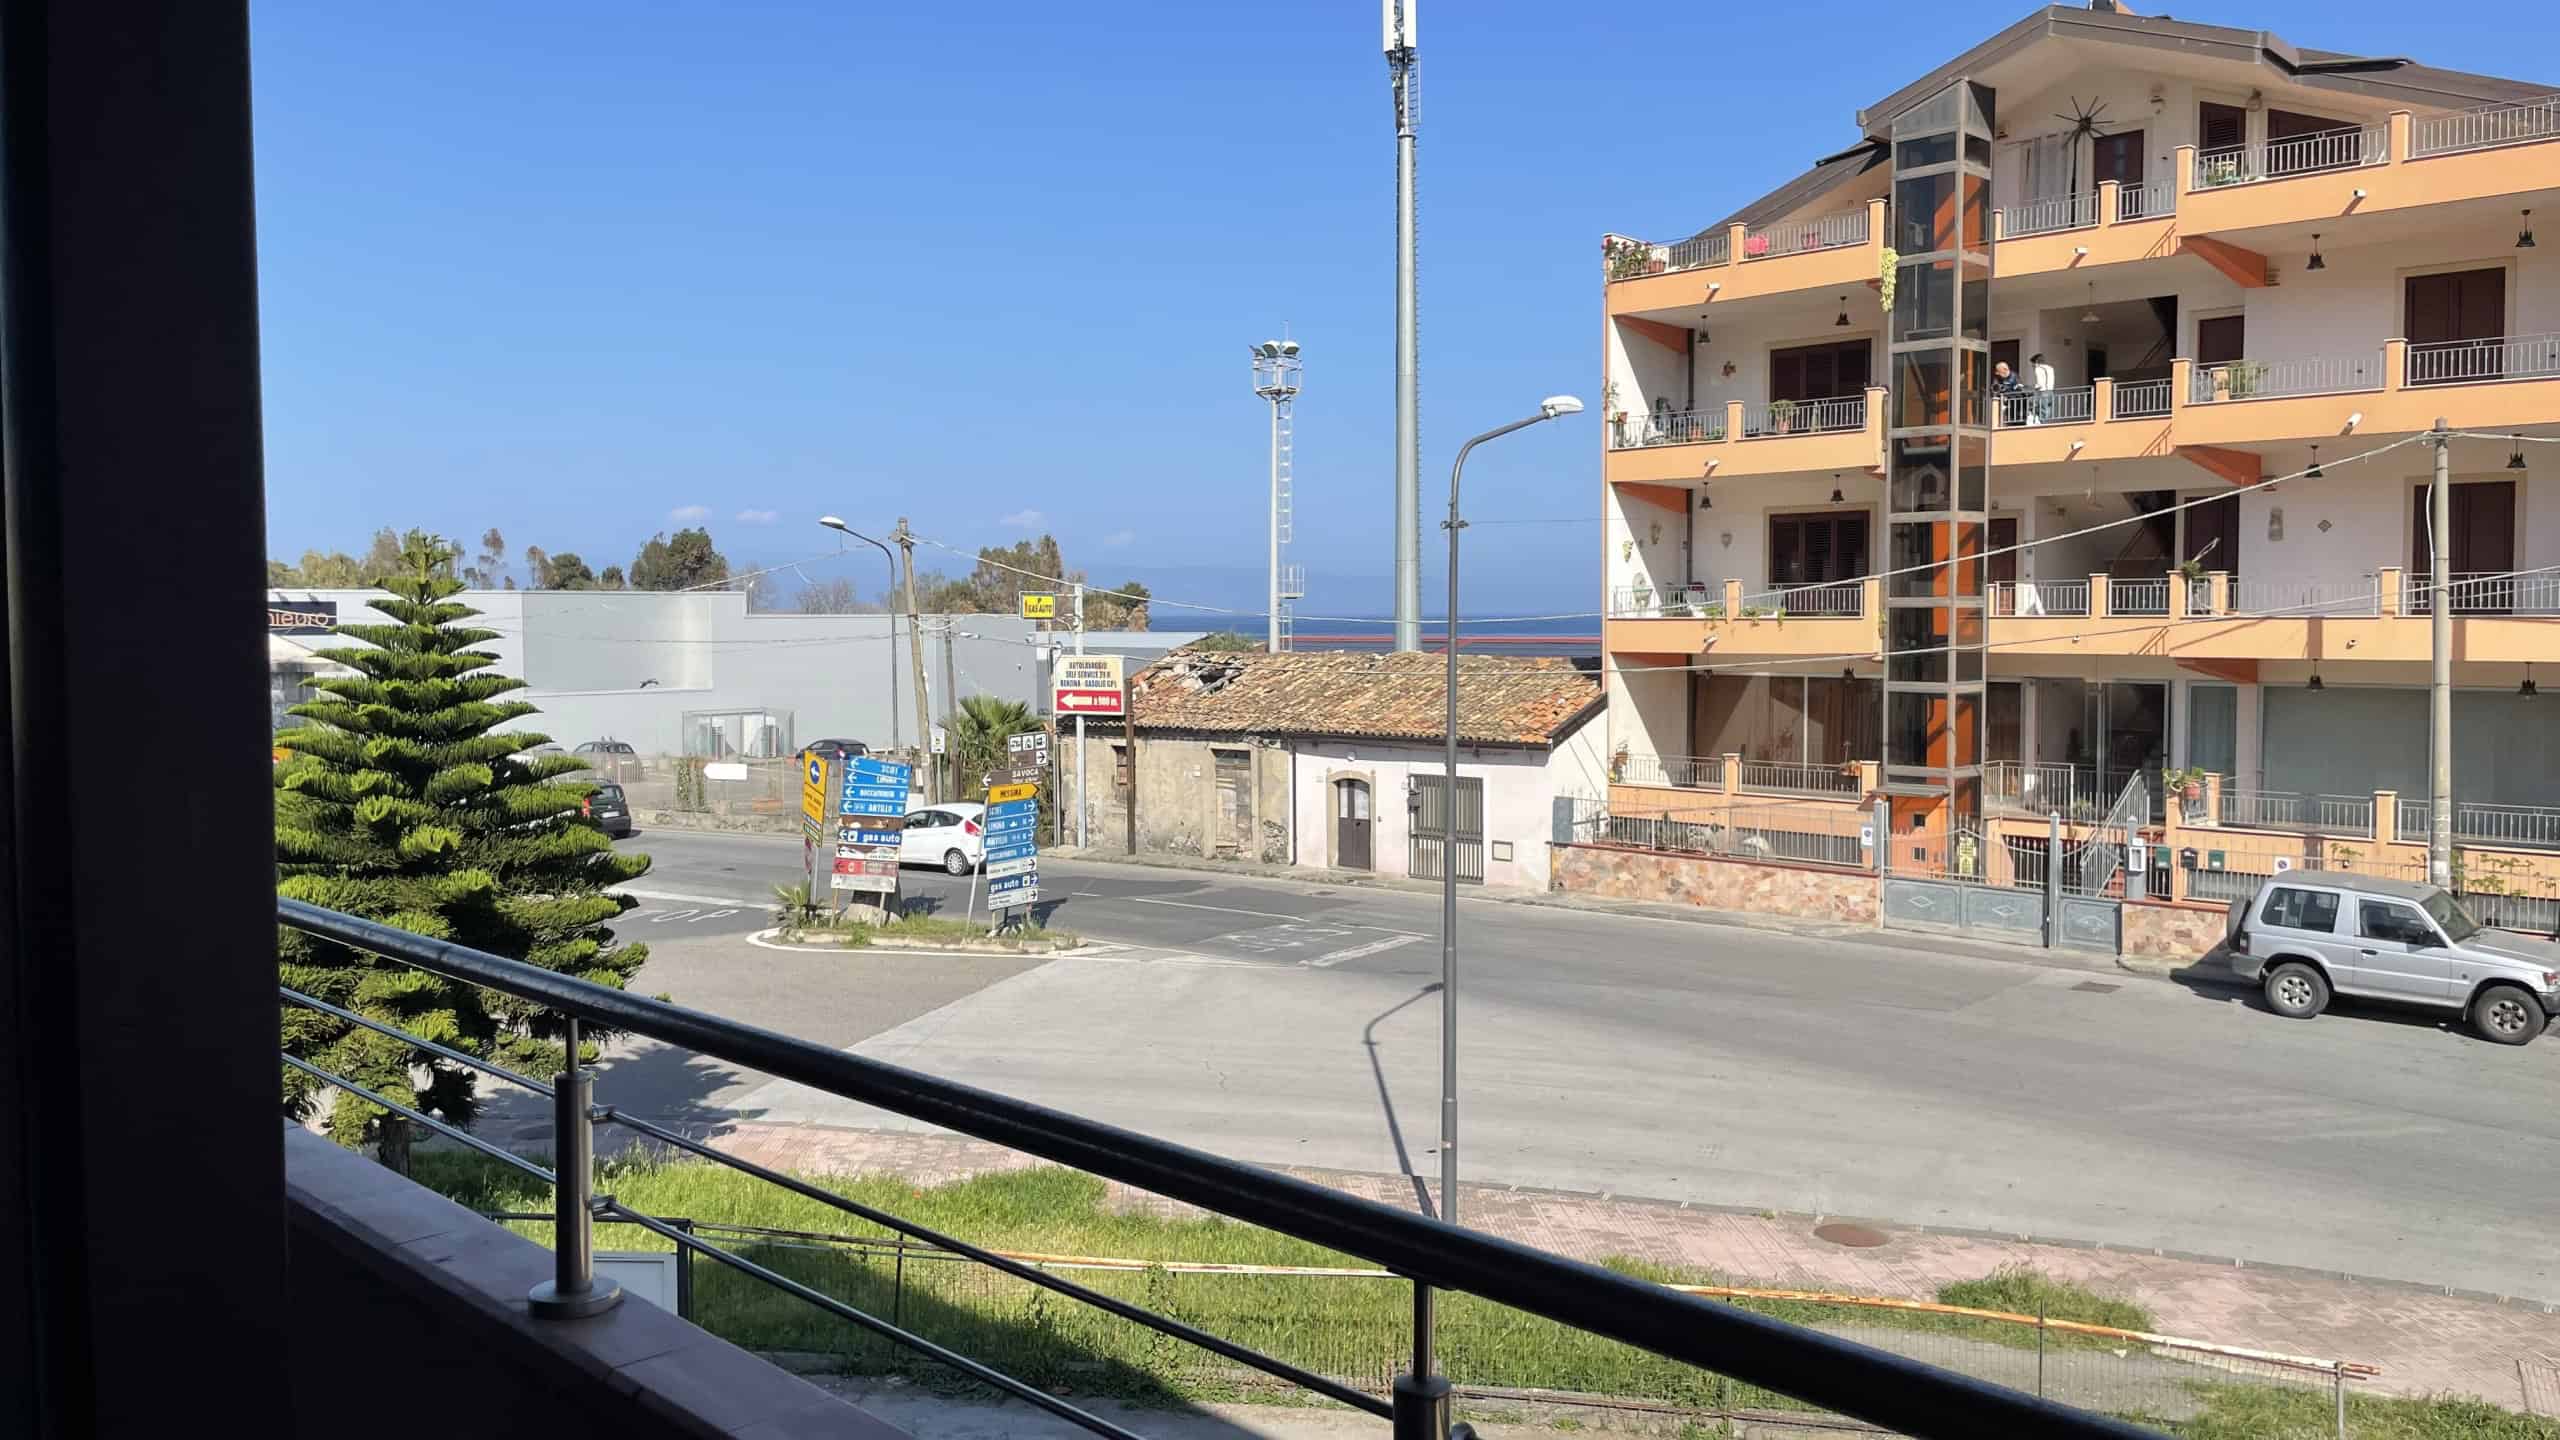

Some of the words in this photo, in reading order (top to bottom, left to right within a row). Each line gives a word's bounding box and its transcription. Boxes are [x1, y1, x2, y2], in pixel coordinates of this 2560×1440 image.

[863, 832, 879, 843] gas
[881, 833, 900, 843] auto
[990, 882, 1002, 894] gas
[1003, 879, 1020, 889] auto
